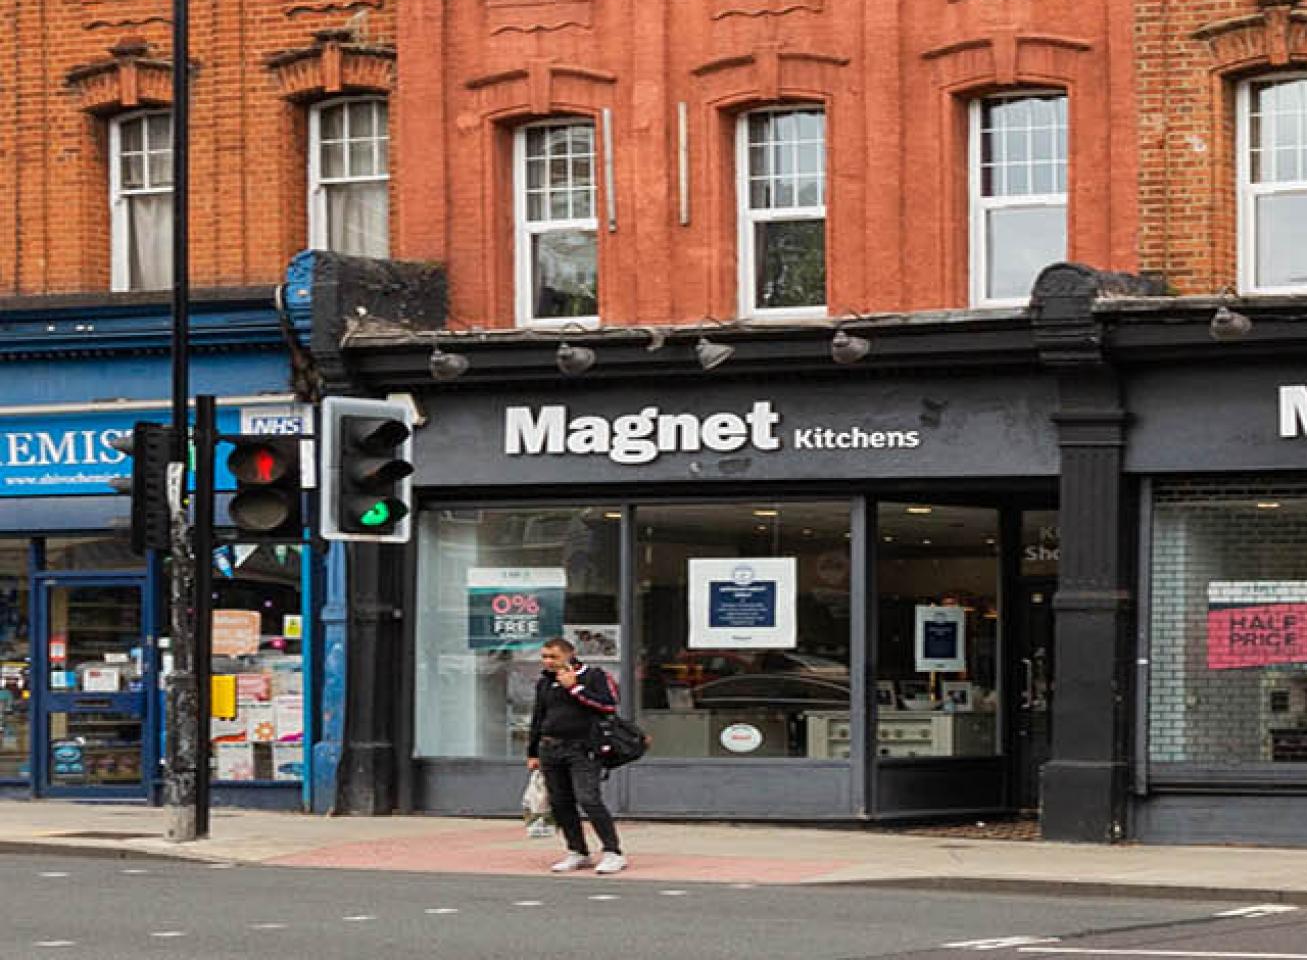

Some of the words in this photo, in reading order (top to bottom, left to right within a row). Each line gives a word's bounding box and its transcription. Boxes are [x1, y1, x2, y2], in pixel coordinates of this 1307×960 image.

[251, 416, 303, 434] NHS
[504, 400, 780, 465] Magnet
[793, 426, 920, 450] Kitchens
[0, 428, 134, 466] EMIS
[491, 594, 540, 614] 0%
[493, 619, 540, 633] FREE
[1229, 614, 1297, 631] HALF
[1229, 632, 1297, 648] PRICE
